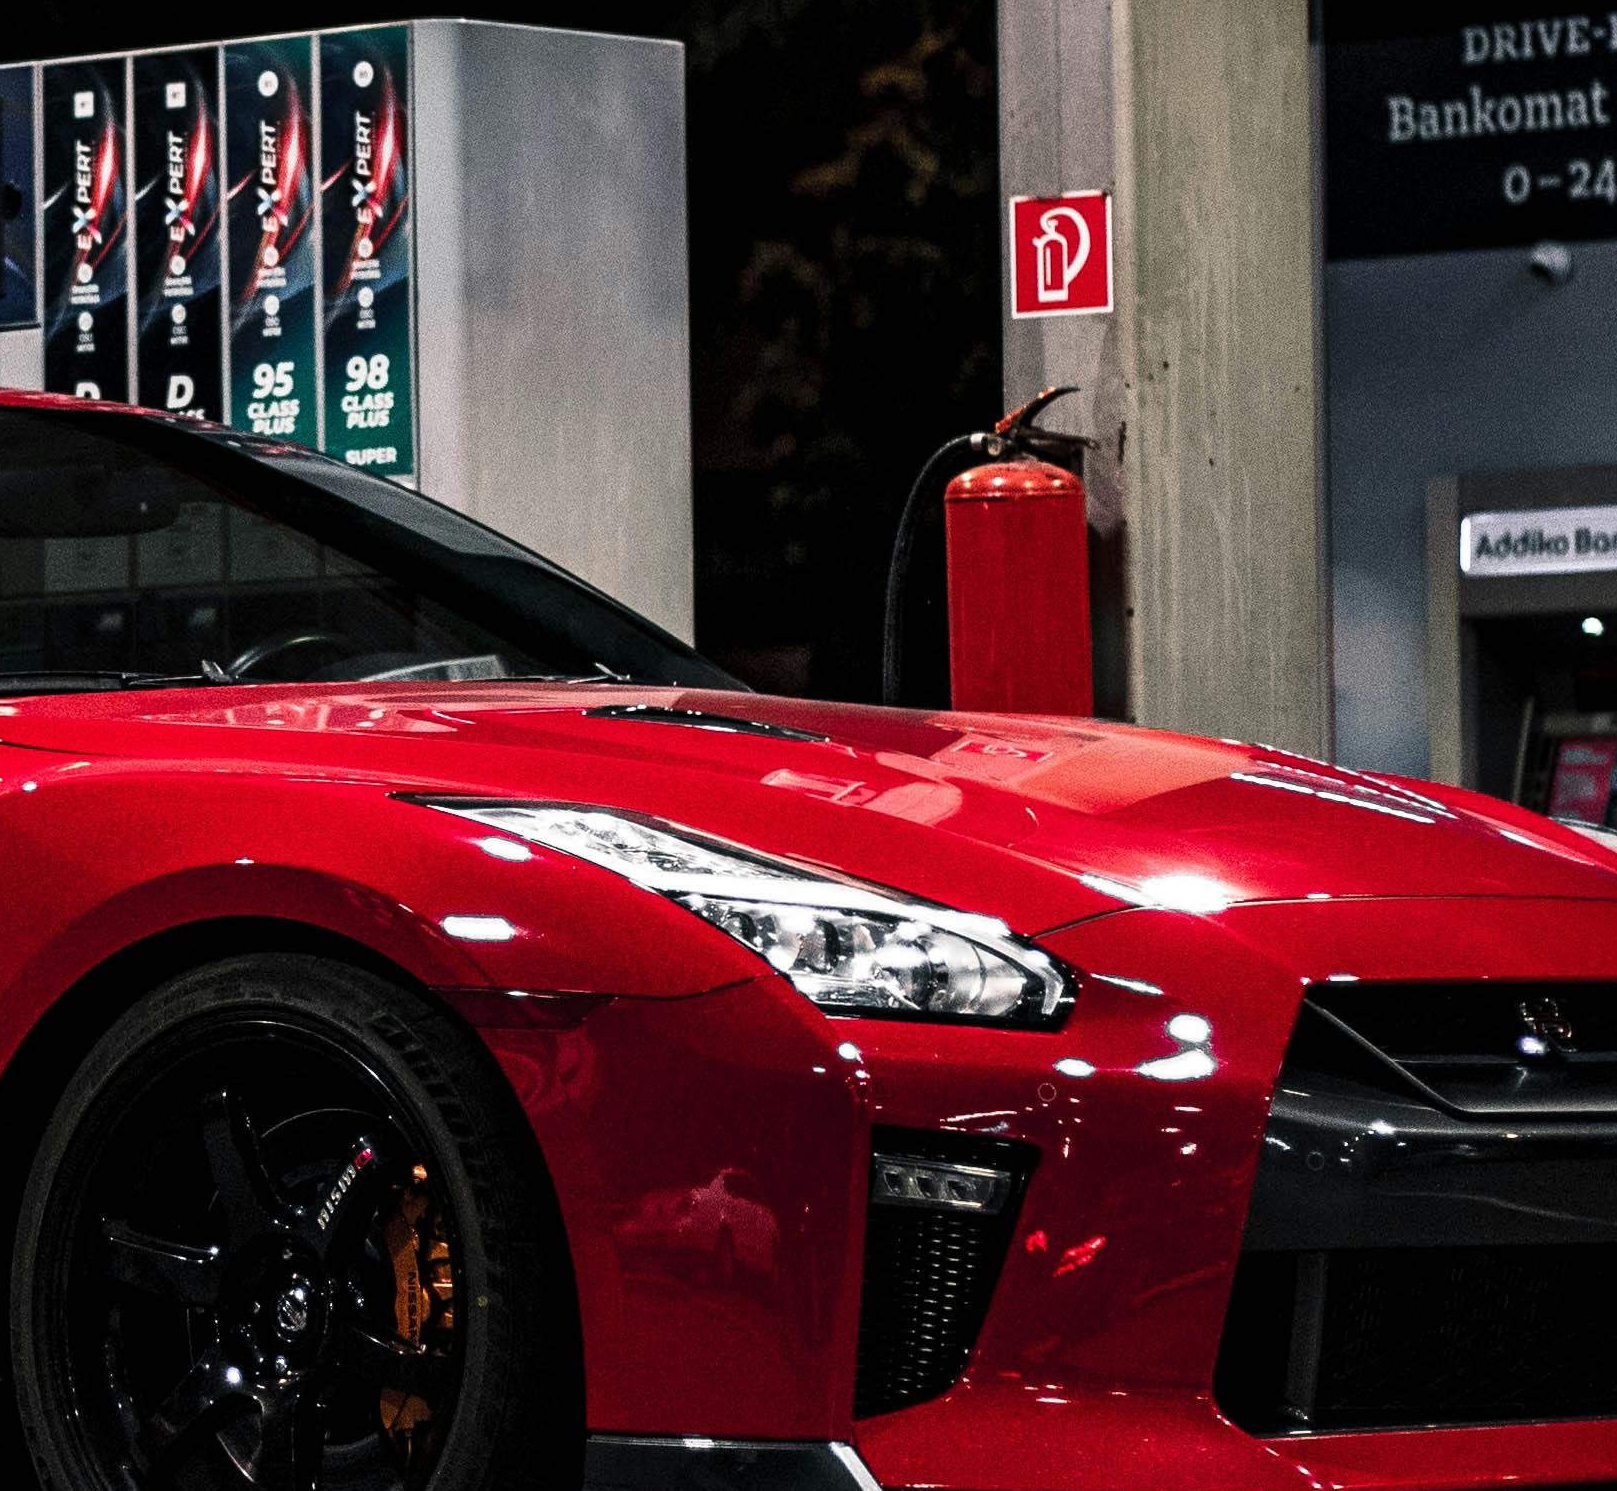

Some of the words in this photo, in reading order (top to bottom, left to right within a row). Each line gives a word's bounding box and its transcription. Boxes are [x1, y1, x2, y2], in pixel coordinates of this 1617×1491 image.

[1386, 80, 1611, 144] Bankomat
[253, 361, 295, 399] 95
[345, 354, 390, 392] 98
[167, 375, 194, 409] D
[341, 391, 395, 413] CLASS
[247, 399, 300, 421] CLASS
[346, 410, 390, 429] PLUS
[252, 417, 295, 435] PLUS
[345, 447, 398, 466] SUPER
[1475, 528, 1570, 559] Addiko
